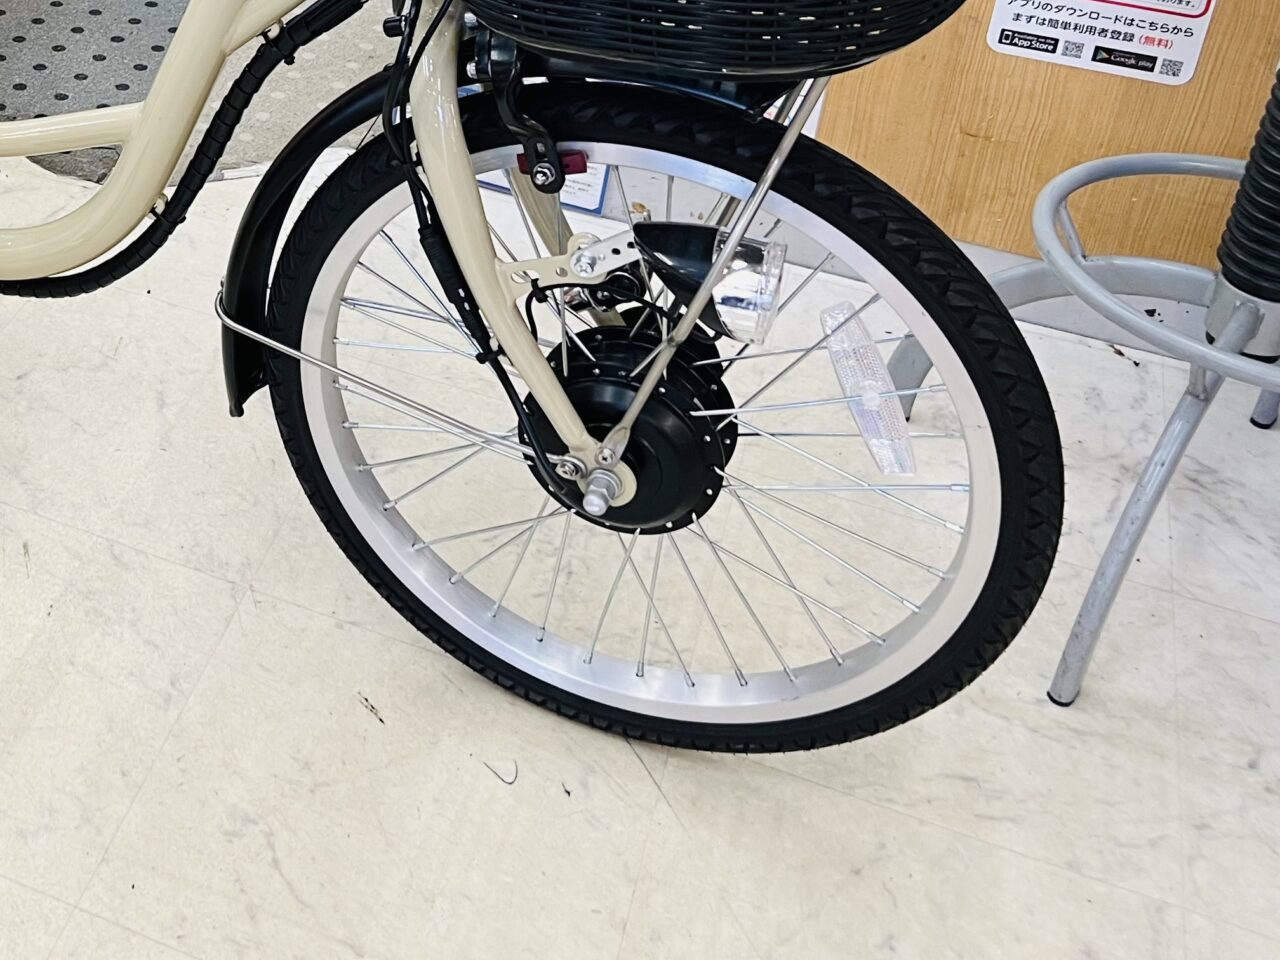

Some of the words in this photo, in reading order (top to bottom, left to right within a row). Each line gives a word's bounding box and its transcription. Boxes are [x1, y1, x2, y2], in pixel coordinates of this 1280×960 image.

[1012, 12, 1136, 43] まずは簡単利用者登録
[1012, 39, 1034, 50] App
[1035, 41, 1054, 51] Store
[1111, 54, 1136, 66] Google
